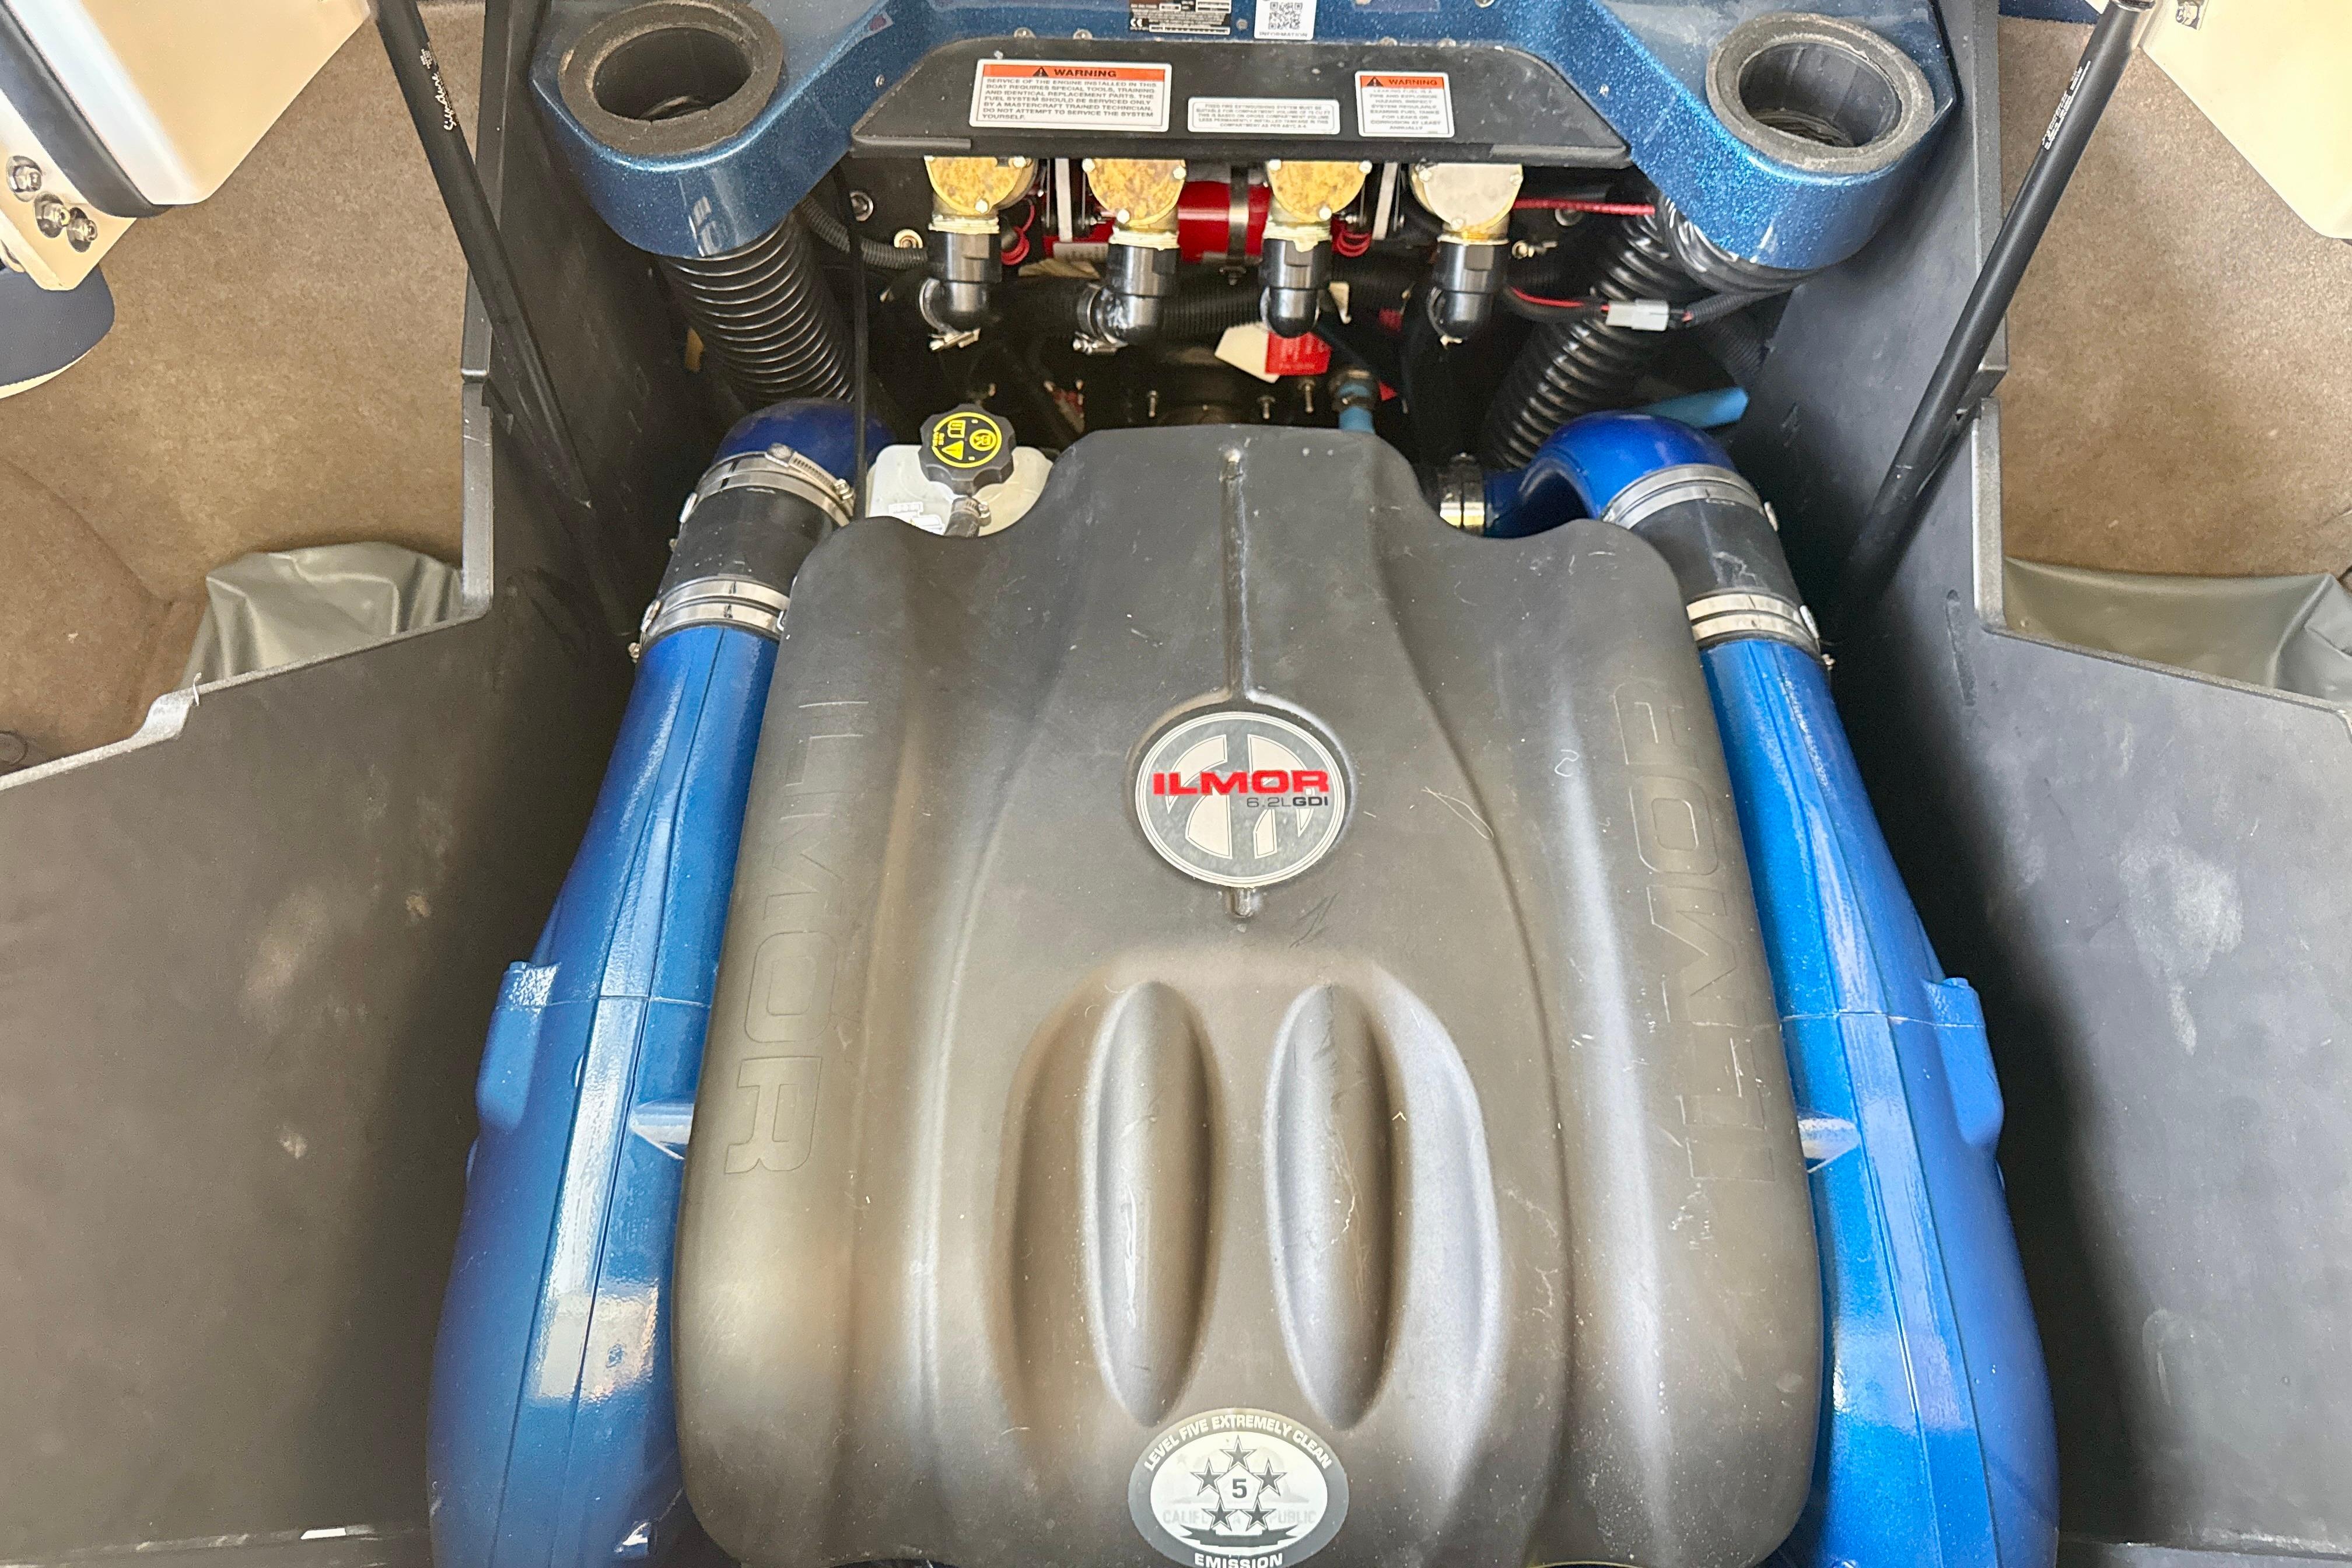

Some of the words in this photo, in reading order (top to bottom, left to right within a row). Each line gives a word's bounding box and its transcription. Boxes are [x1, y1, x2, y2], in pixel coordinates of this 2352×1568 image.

[1054, 68, 1117, 78] WARNING
[1153, 770, 1329, 795] ILMOR
[1144, 1435, 1180, 1471] LEVEL
[1179, 1419, 1209, 1441] FIVE
[1211, 1414, 1293, 1437] EXTREMELY
[1292, 1430, 1332, 1469] CLEAN
[1232, 1478, 1247, 1499] 5
[1195, 1553, 1283, 1568] EMISSION
